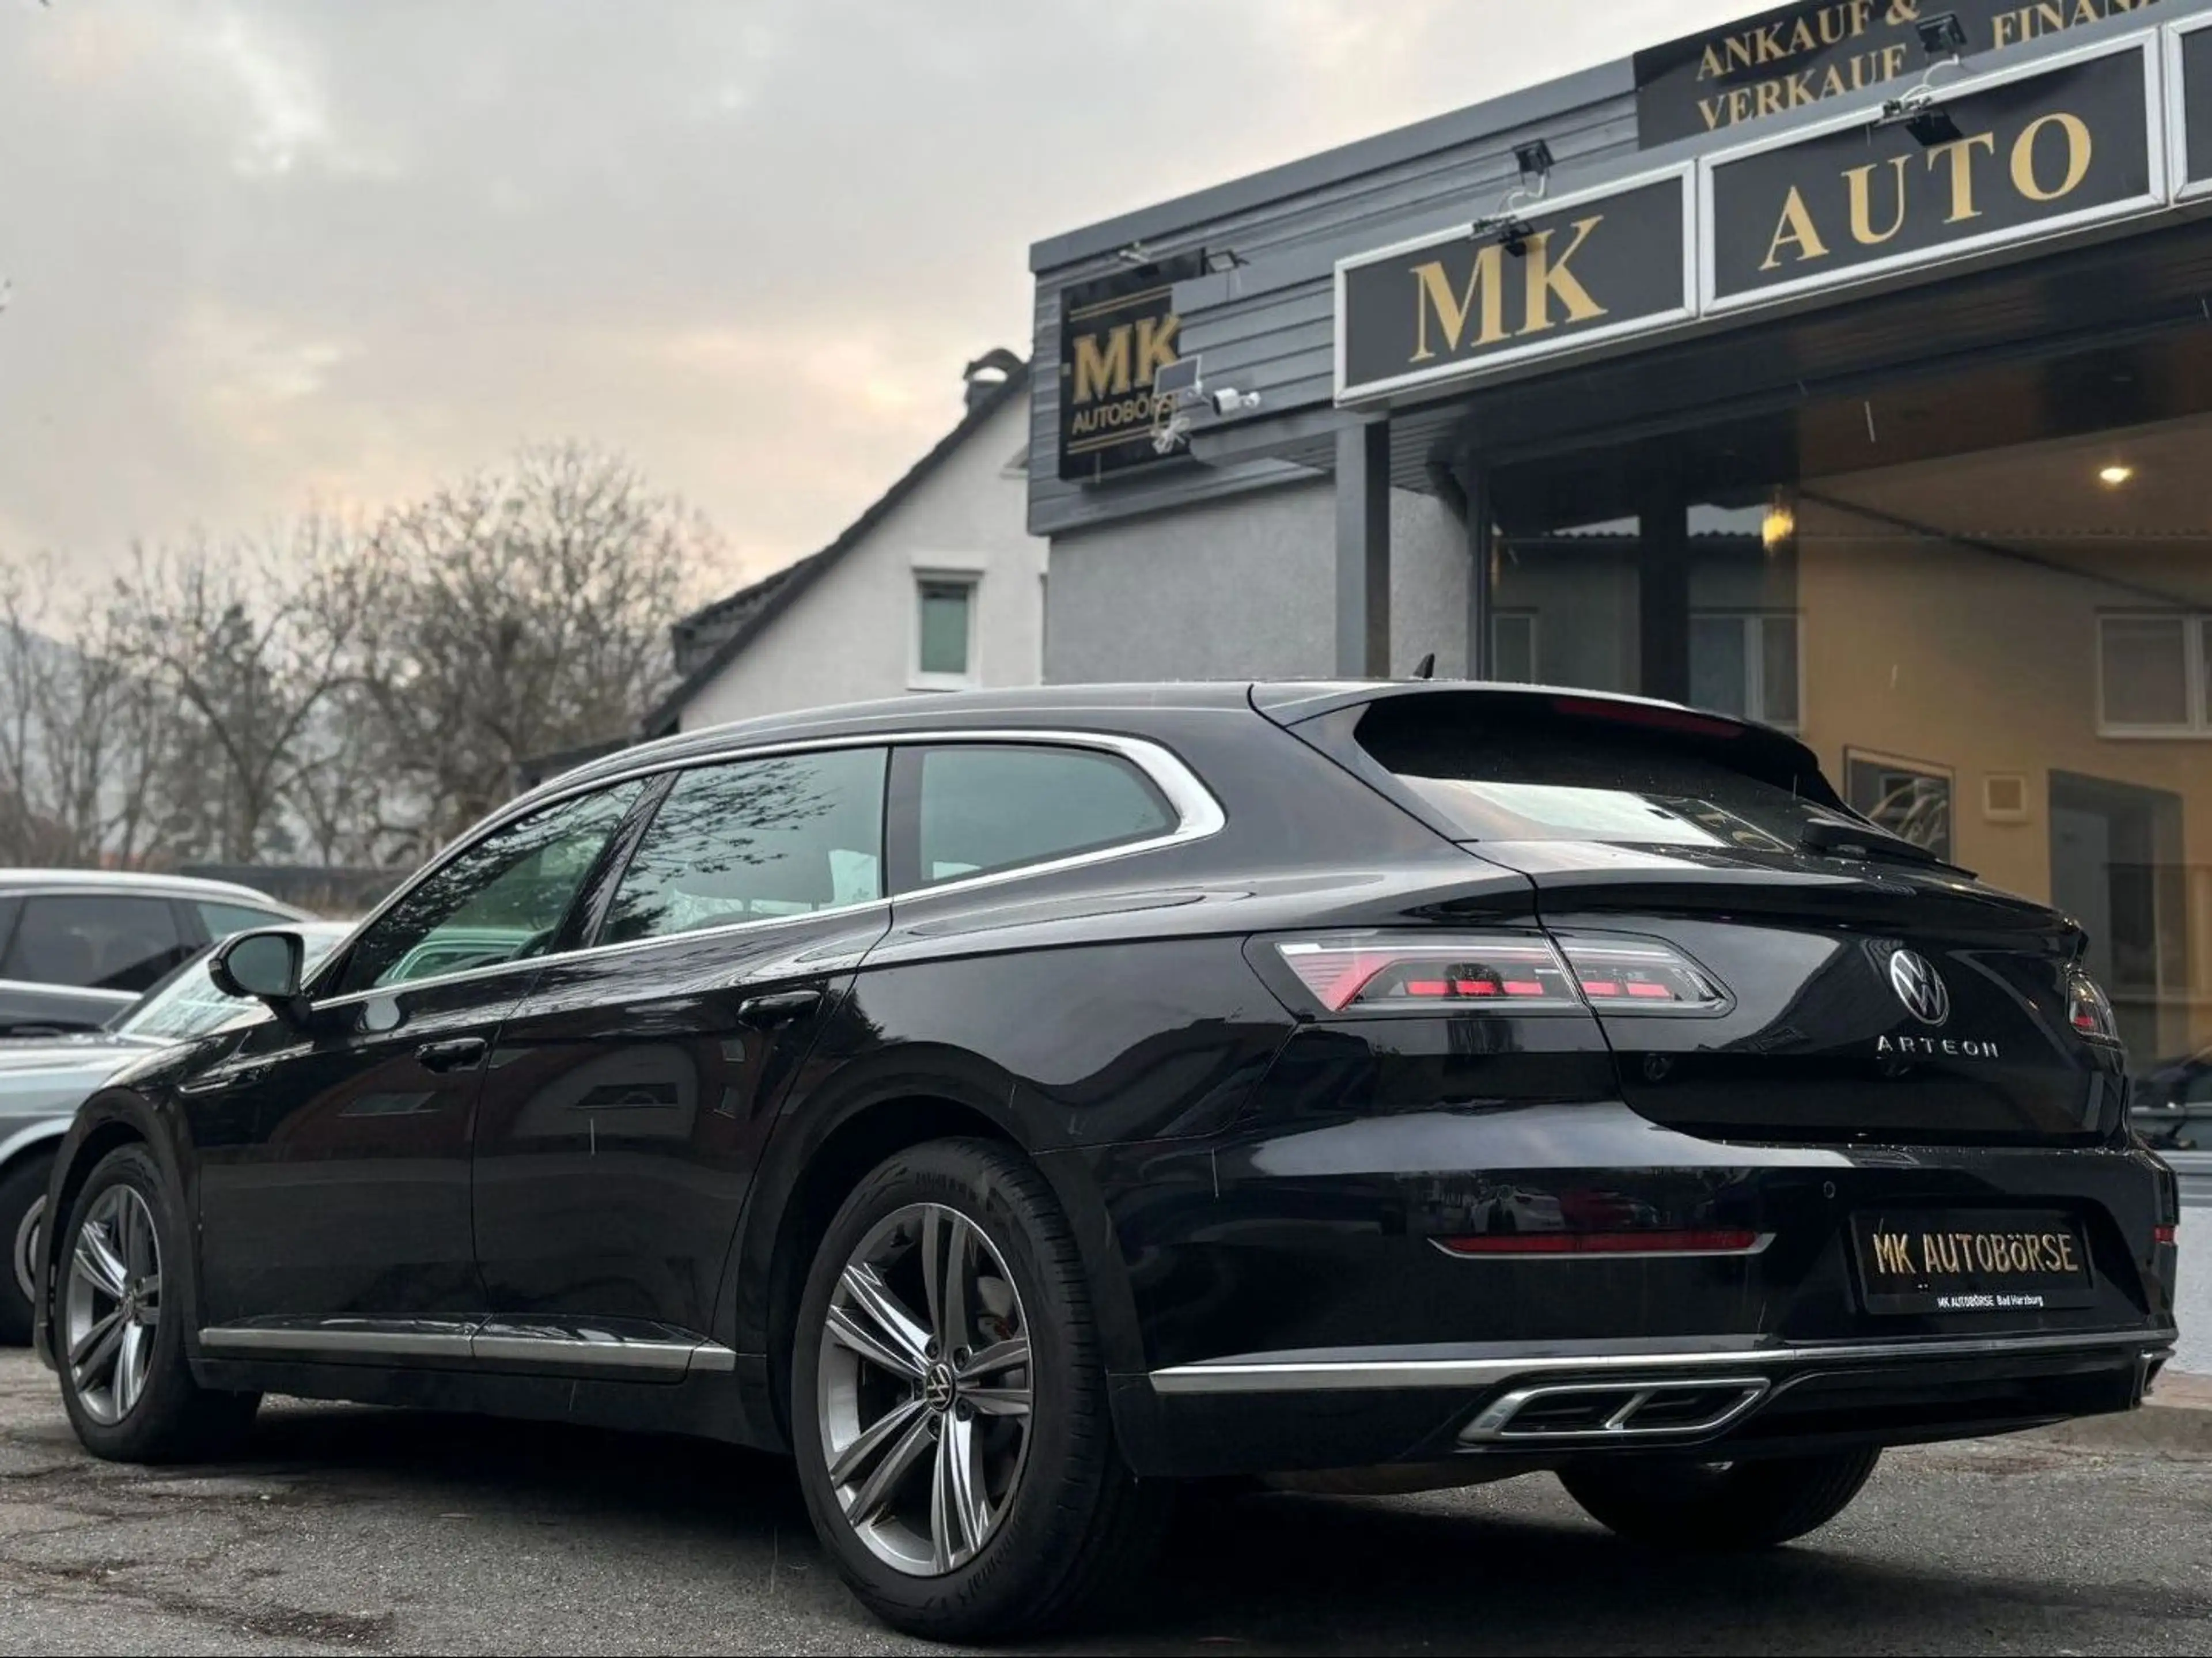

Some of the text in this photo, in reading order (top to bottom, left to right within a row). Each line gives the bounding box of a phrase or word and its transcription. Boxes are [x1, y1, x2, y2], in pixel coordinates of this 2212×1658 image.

[1696, 0, 1921, 81] ANKAUF &
[1993, 0, 2160, 50] FINA
[1696, 44, 1906, 131] VERKAUF
[1409, 112, 2092, 362] MK AUTO
[1073, 313, 1181, 403] MK
[1877, 1035, 1999, 1058] ARTEON
[1873, 1233, 2078, 1274] MK AUTOBÖRSE
